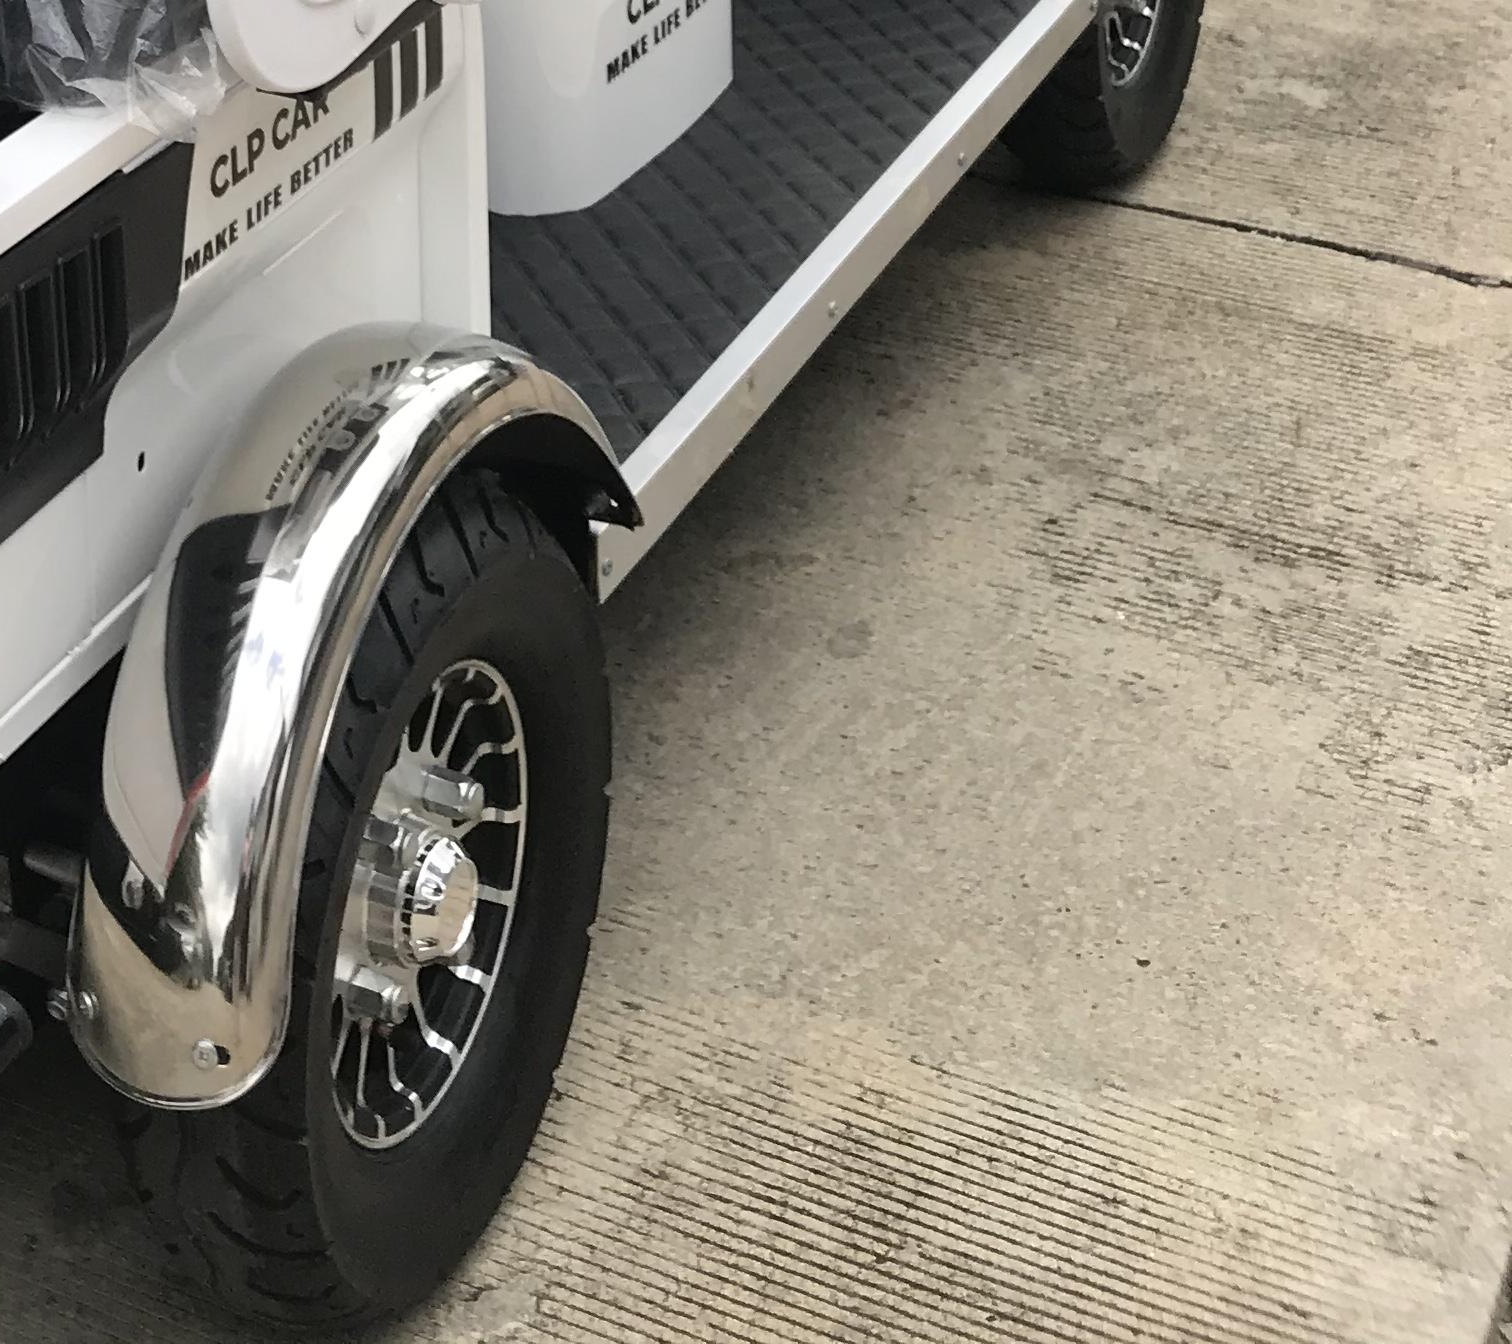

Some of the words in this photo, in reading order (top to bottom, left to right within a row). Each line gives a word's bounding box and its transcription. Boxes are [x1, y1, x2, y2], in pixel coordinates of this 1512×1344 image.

[606, 34, 648, 84] MAKE
[653, 7, 681, 45] LIFE
[210, 128, 265, 198] CLP
[184, 219, 238, 281] MAKE
[246, 184, 282, 231] LIFE
[290, 128, 353, 195] BETTER
